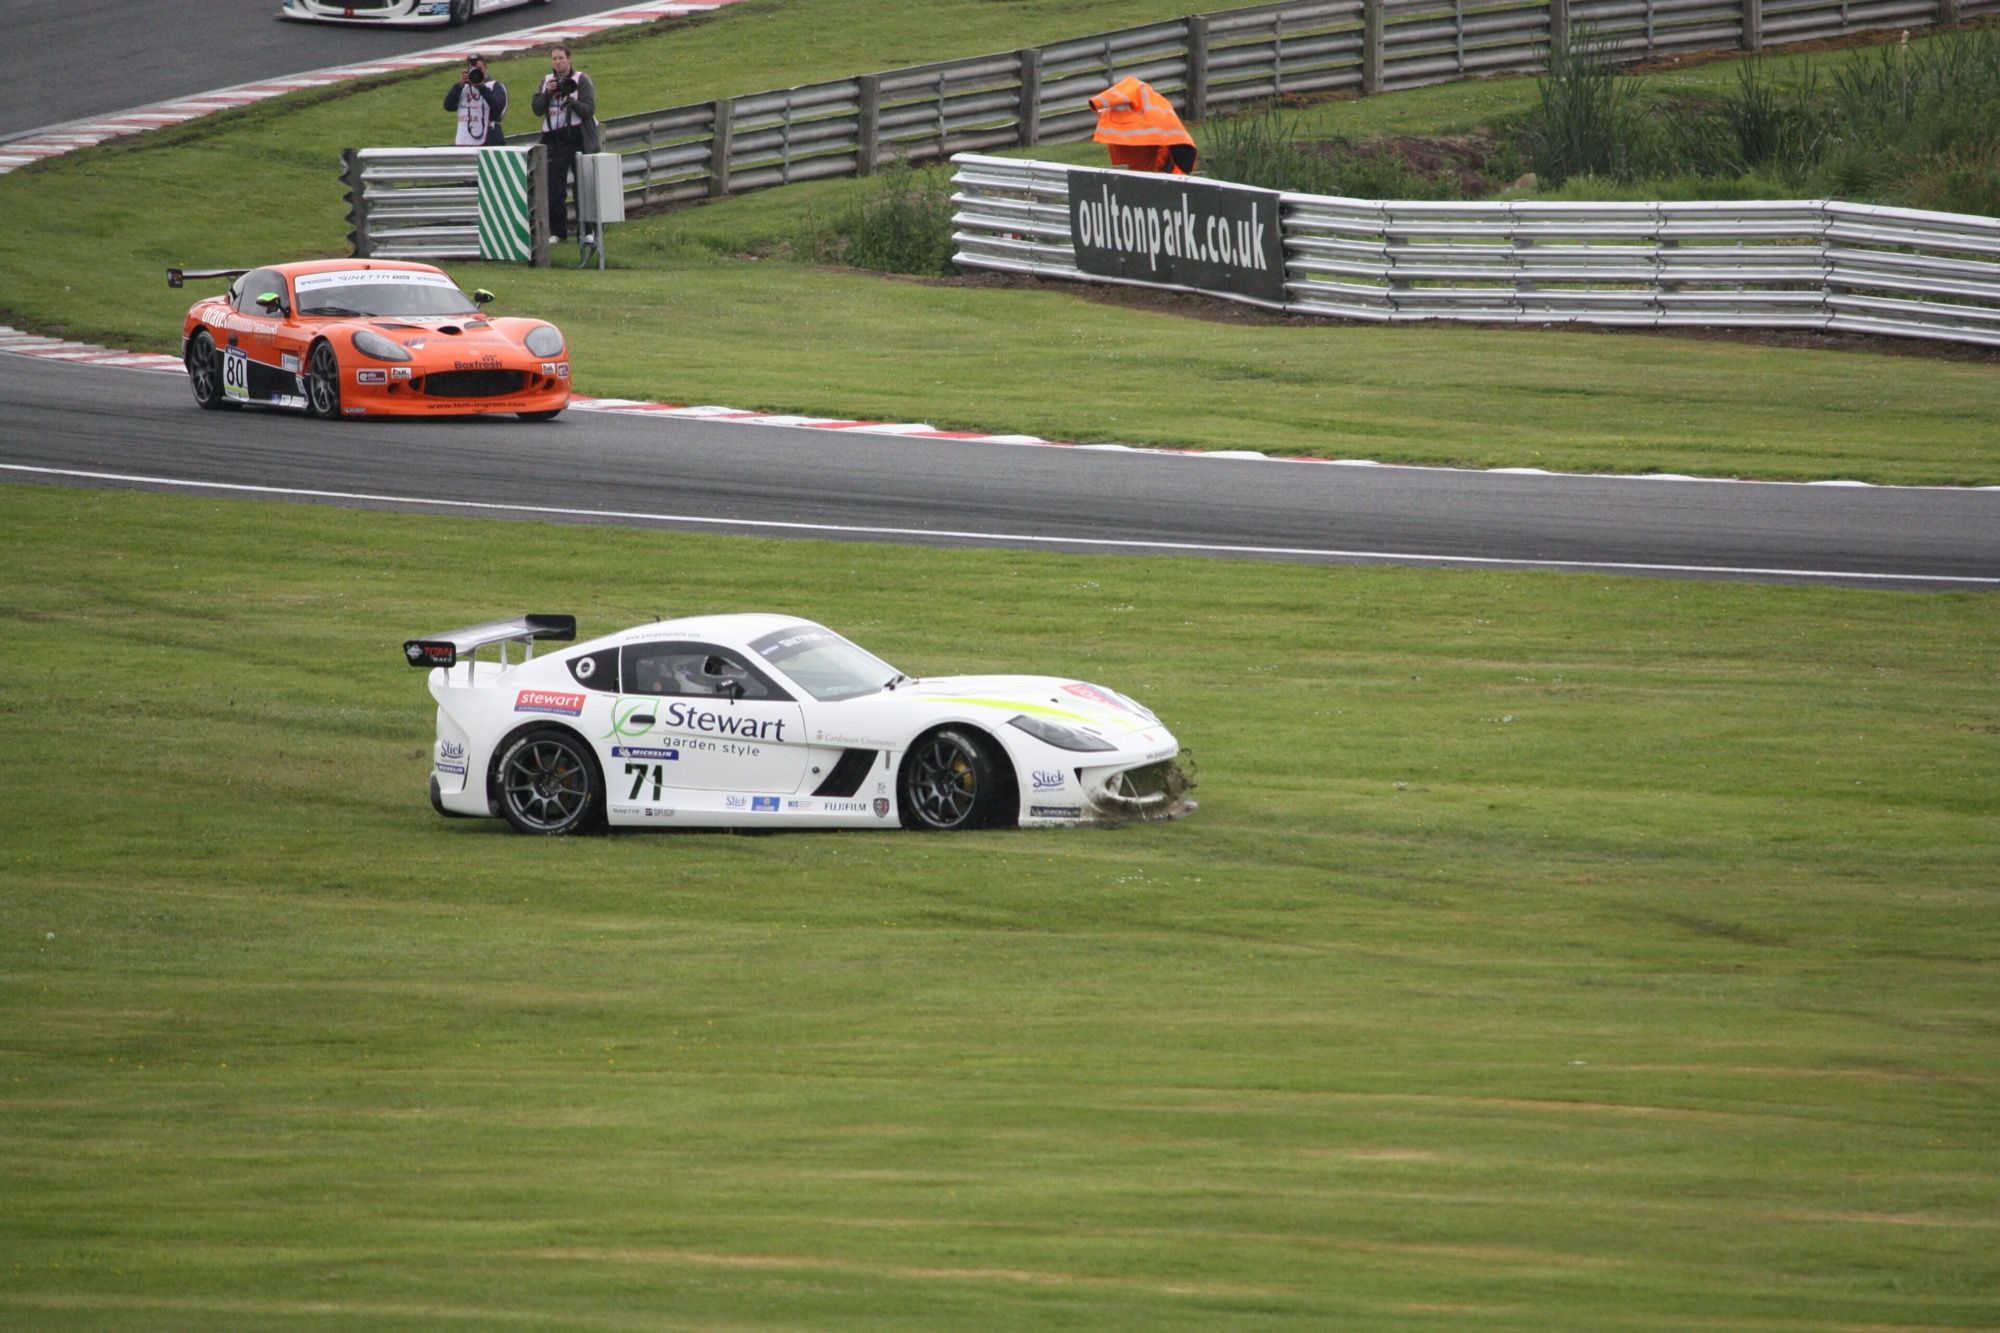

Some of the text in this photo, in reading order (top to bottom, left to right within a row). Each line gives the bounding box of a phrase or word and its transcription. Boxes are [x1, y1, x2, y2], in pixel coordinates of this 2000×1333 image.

[1079, 183, 1267, 271] oultonpark.co.uk
[227, 356, 244, 388] 80
[454, 360, 503, 369] Boxfresh
[521, 693, 580, 707] stewart
[666, 702, 786, 742] Stewart
[441, 740, 464, 758] Slick
[632, 749, 672, 758] MICHELIN
[663, 736, 760, 757] garden style
[625, 763, 663, 801] 71
[1032, 770, 1065, 788] Slick
[825, 803, 867, 812] FUJIFILM
